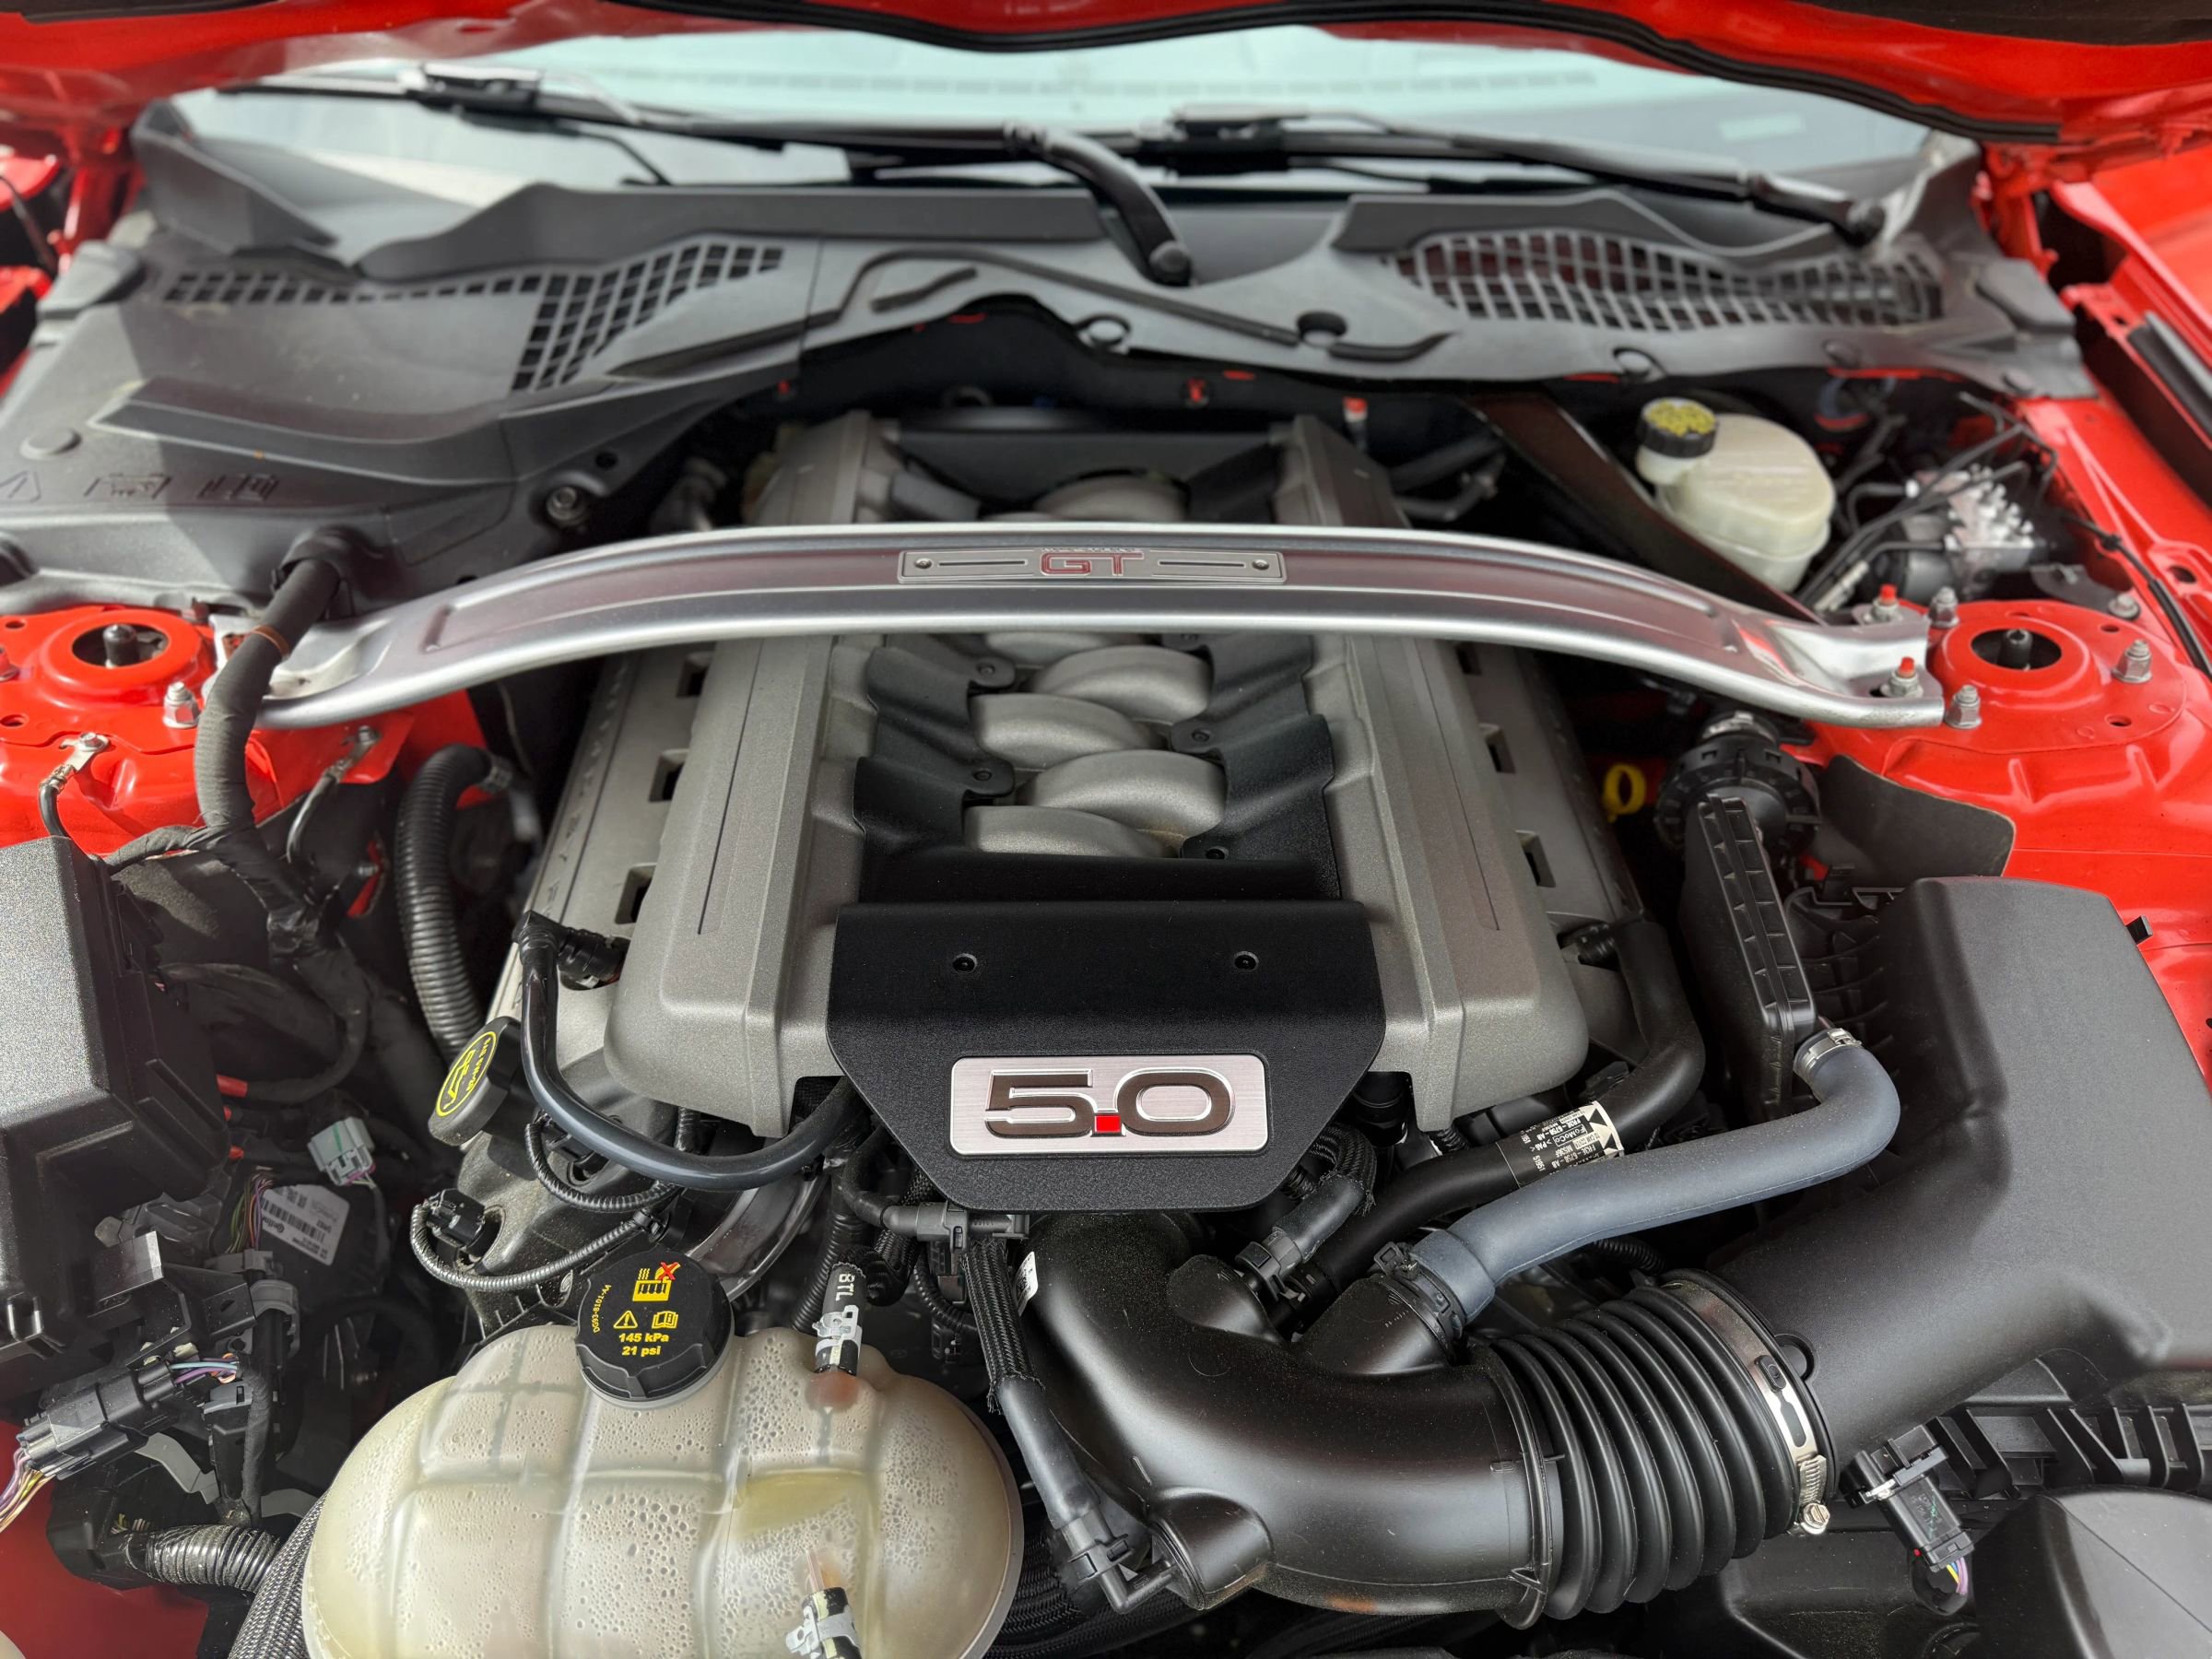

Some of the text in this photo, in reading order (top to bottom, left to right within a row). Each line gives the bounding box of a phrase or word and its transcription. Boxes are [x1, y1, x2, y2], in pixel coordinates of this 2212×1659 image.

[1040, 552, 1145, 575] GT
[984, 1066, 1236, 1138] 5.0
[1554, 1127, 1586, 1144] FoMoCo
[618, 1333, 669, 1343] 145 kPa
[621, 1346, 661, 1358] 21 psi
